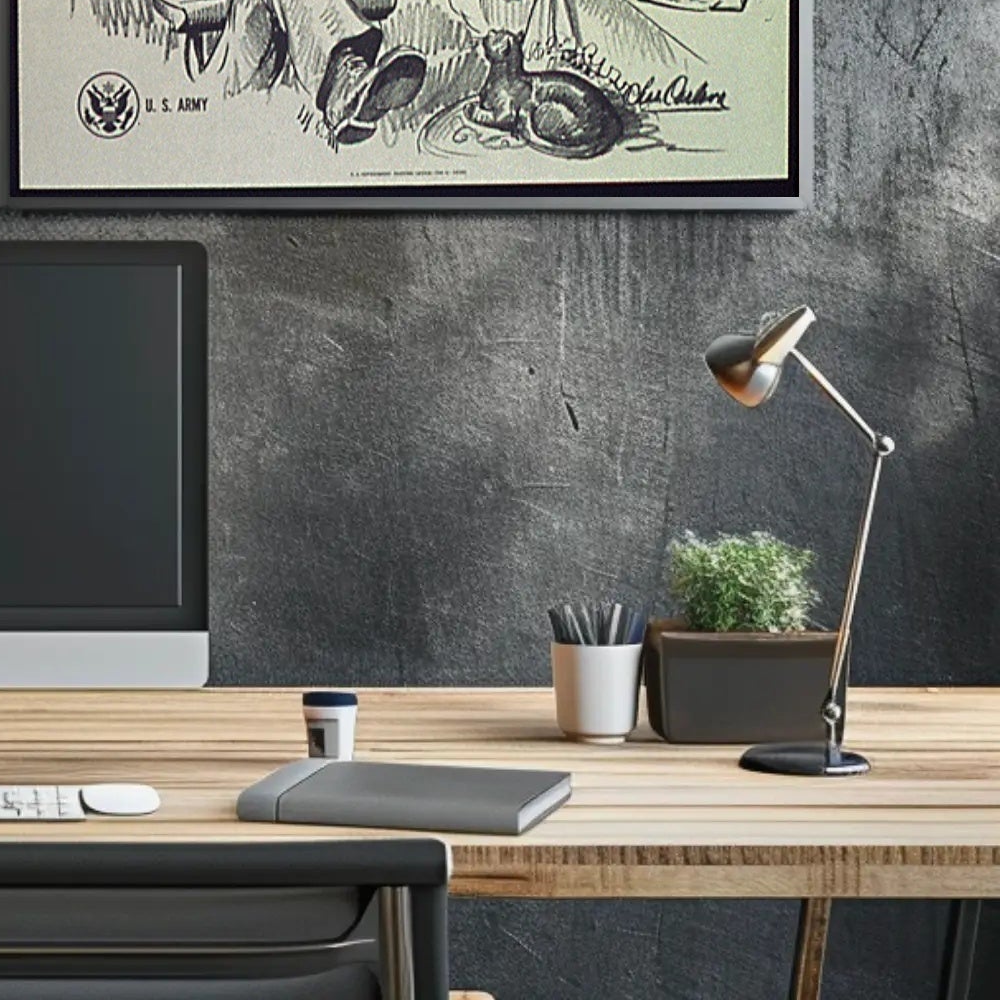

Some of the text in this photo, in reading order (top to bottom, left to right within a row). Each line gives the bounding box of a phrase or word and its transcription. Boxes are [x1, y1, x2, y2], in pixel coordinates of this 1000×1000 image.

[145, 97, 208, 113] U. S. ARMY
